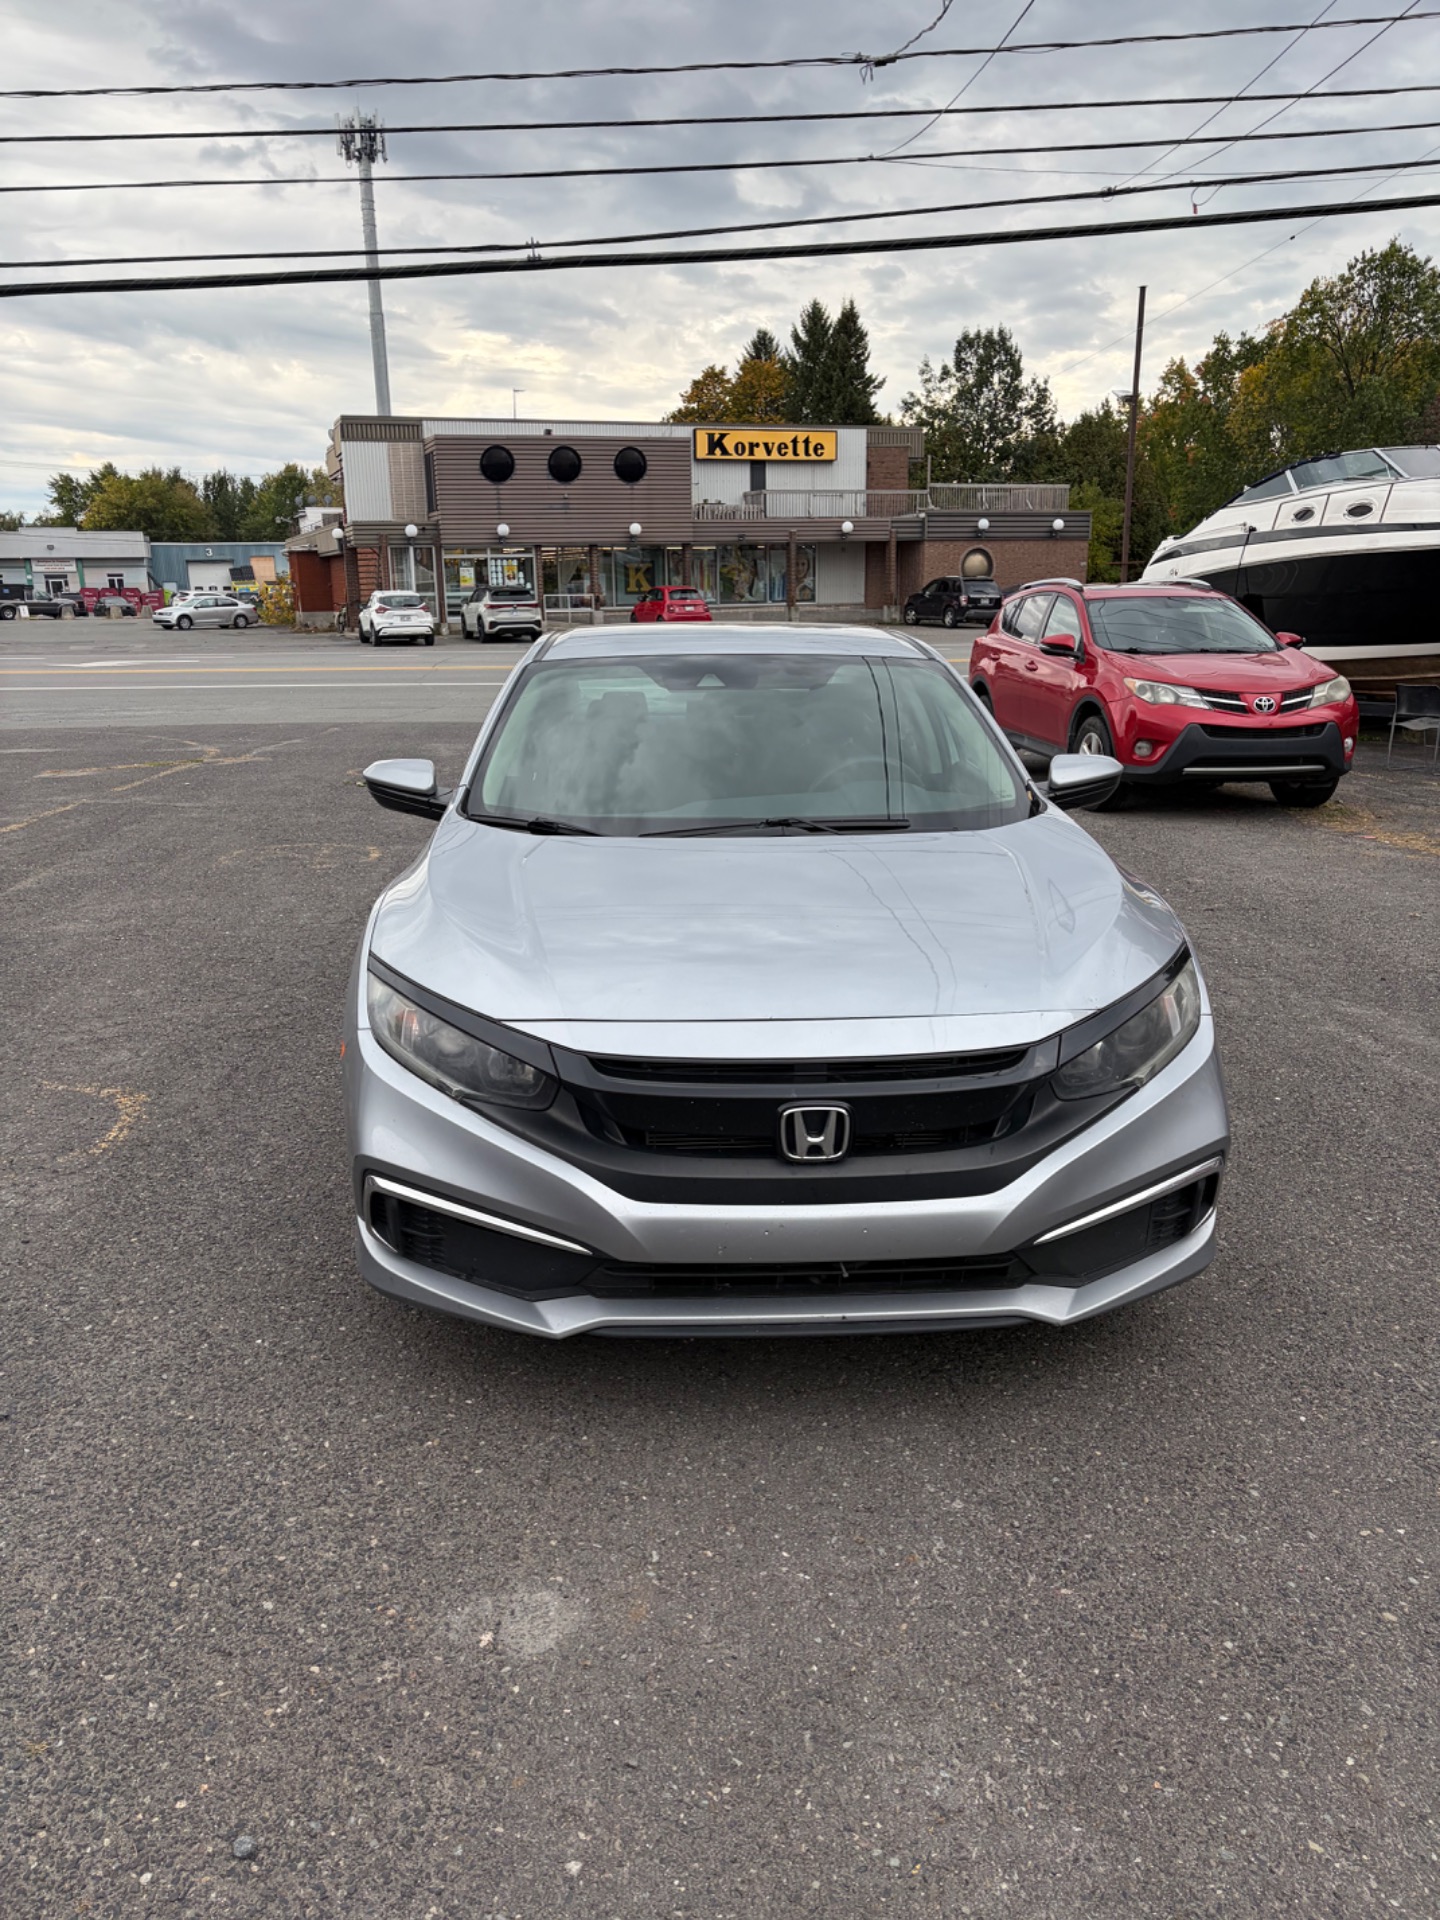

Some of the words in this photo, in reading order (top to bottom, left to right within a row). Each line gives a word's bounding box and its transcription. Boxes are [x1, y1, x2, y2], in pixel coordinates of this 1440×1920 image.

[705, 432, 825, 457] Korvette
[205, 548, 213, 557] 3
[625, 563, 653, 592] K
